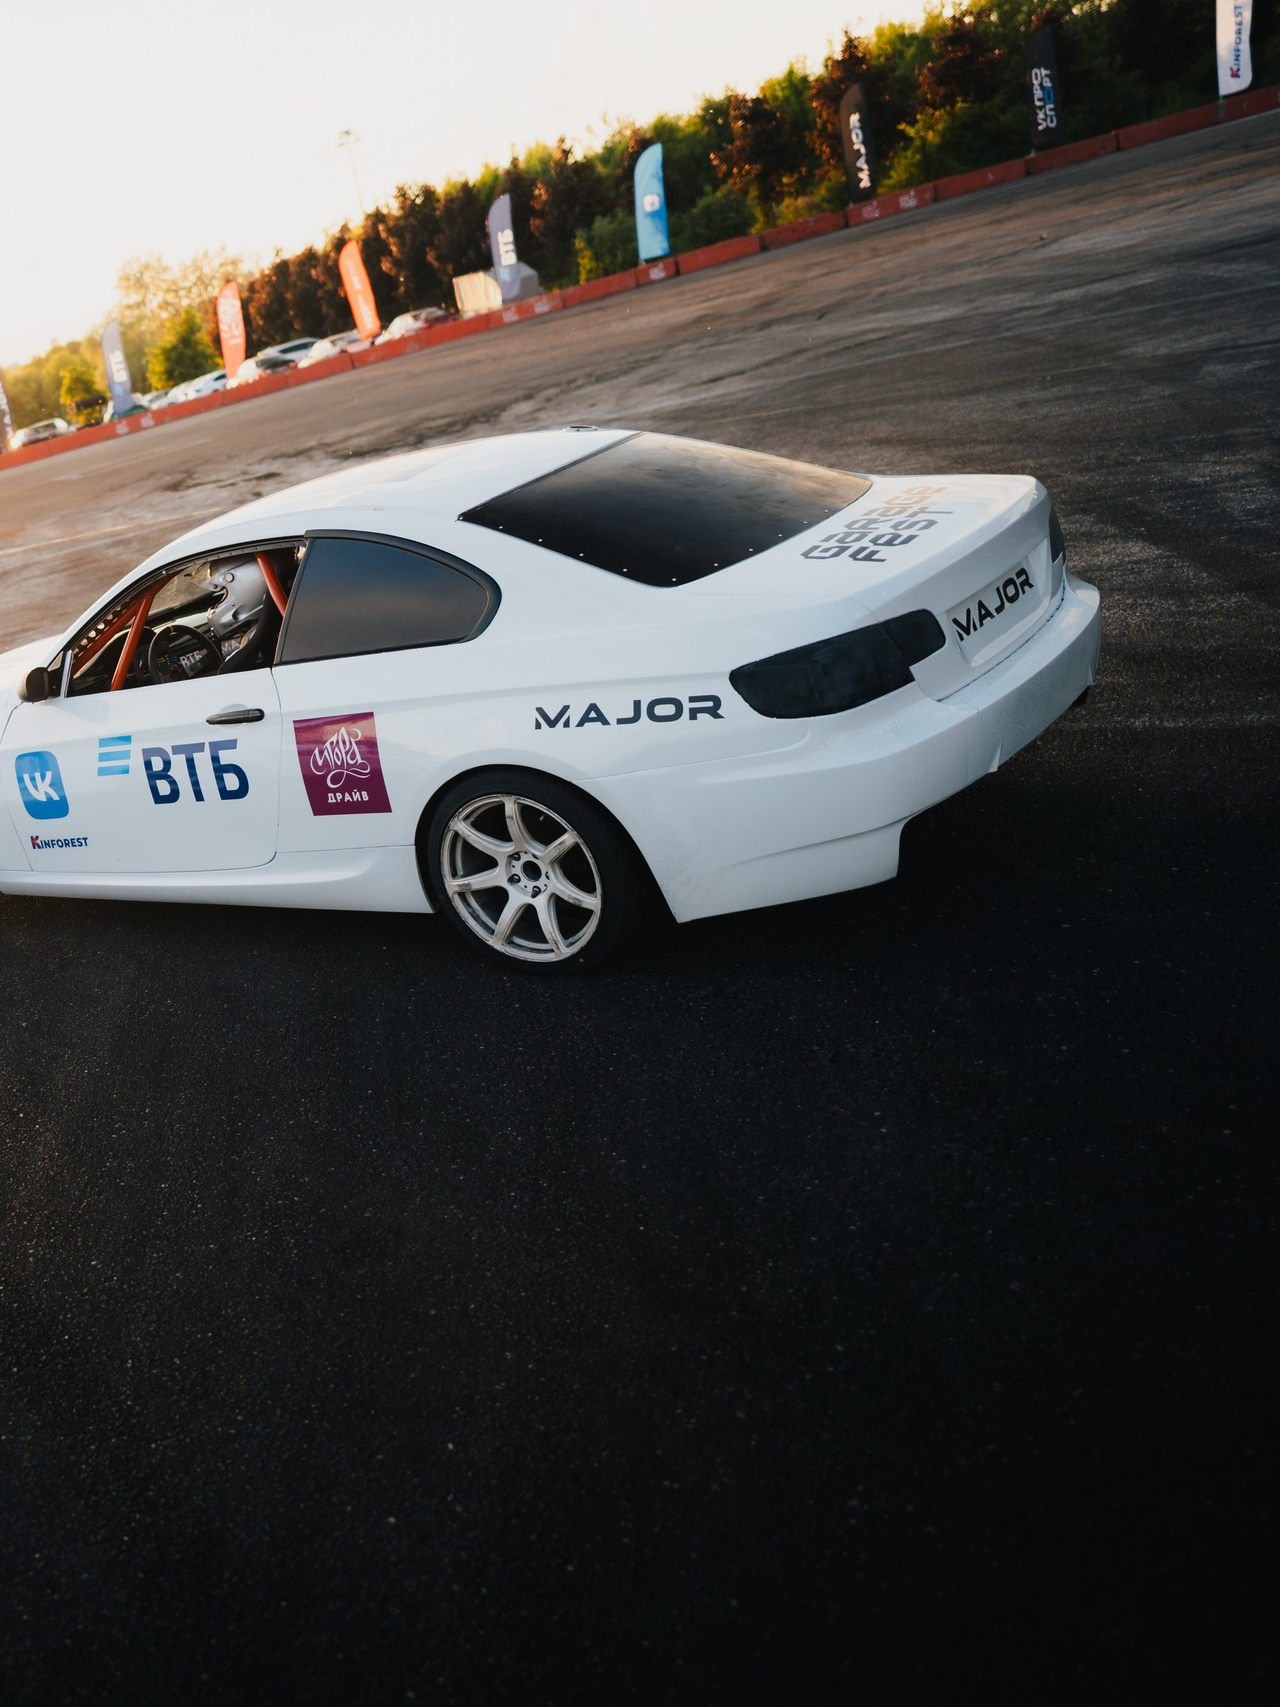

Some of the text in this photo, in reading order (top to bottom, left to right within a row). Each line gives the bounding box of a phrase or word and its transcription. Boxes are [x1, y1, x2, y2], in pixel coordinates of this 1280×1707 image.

[1230, 5, 1243, 79] KINFOREST
[1040, 67, 1057, 128] СПОРТ
[849, 112, 871, 189] MAJOR
[951, 567, 1034, 642] MAJOR
[534, 694, 725, 730] MAJOR
[23, 770, 61, 802] VK
[141, 738, 250, 805] ВТБ
[327, 789, 369, 803] ДРАЙВ
[30, 835, 89, 850] KINFOREST
